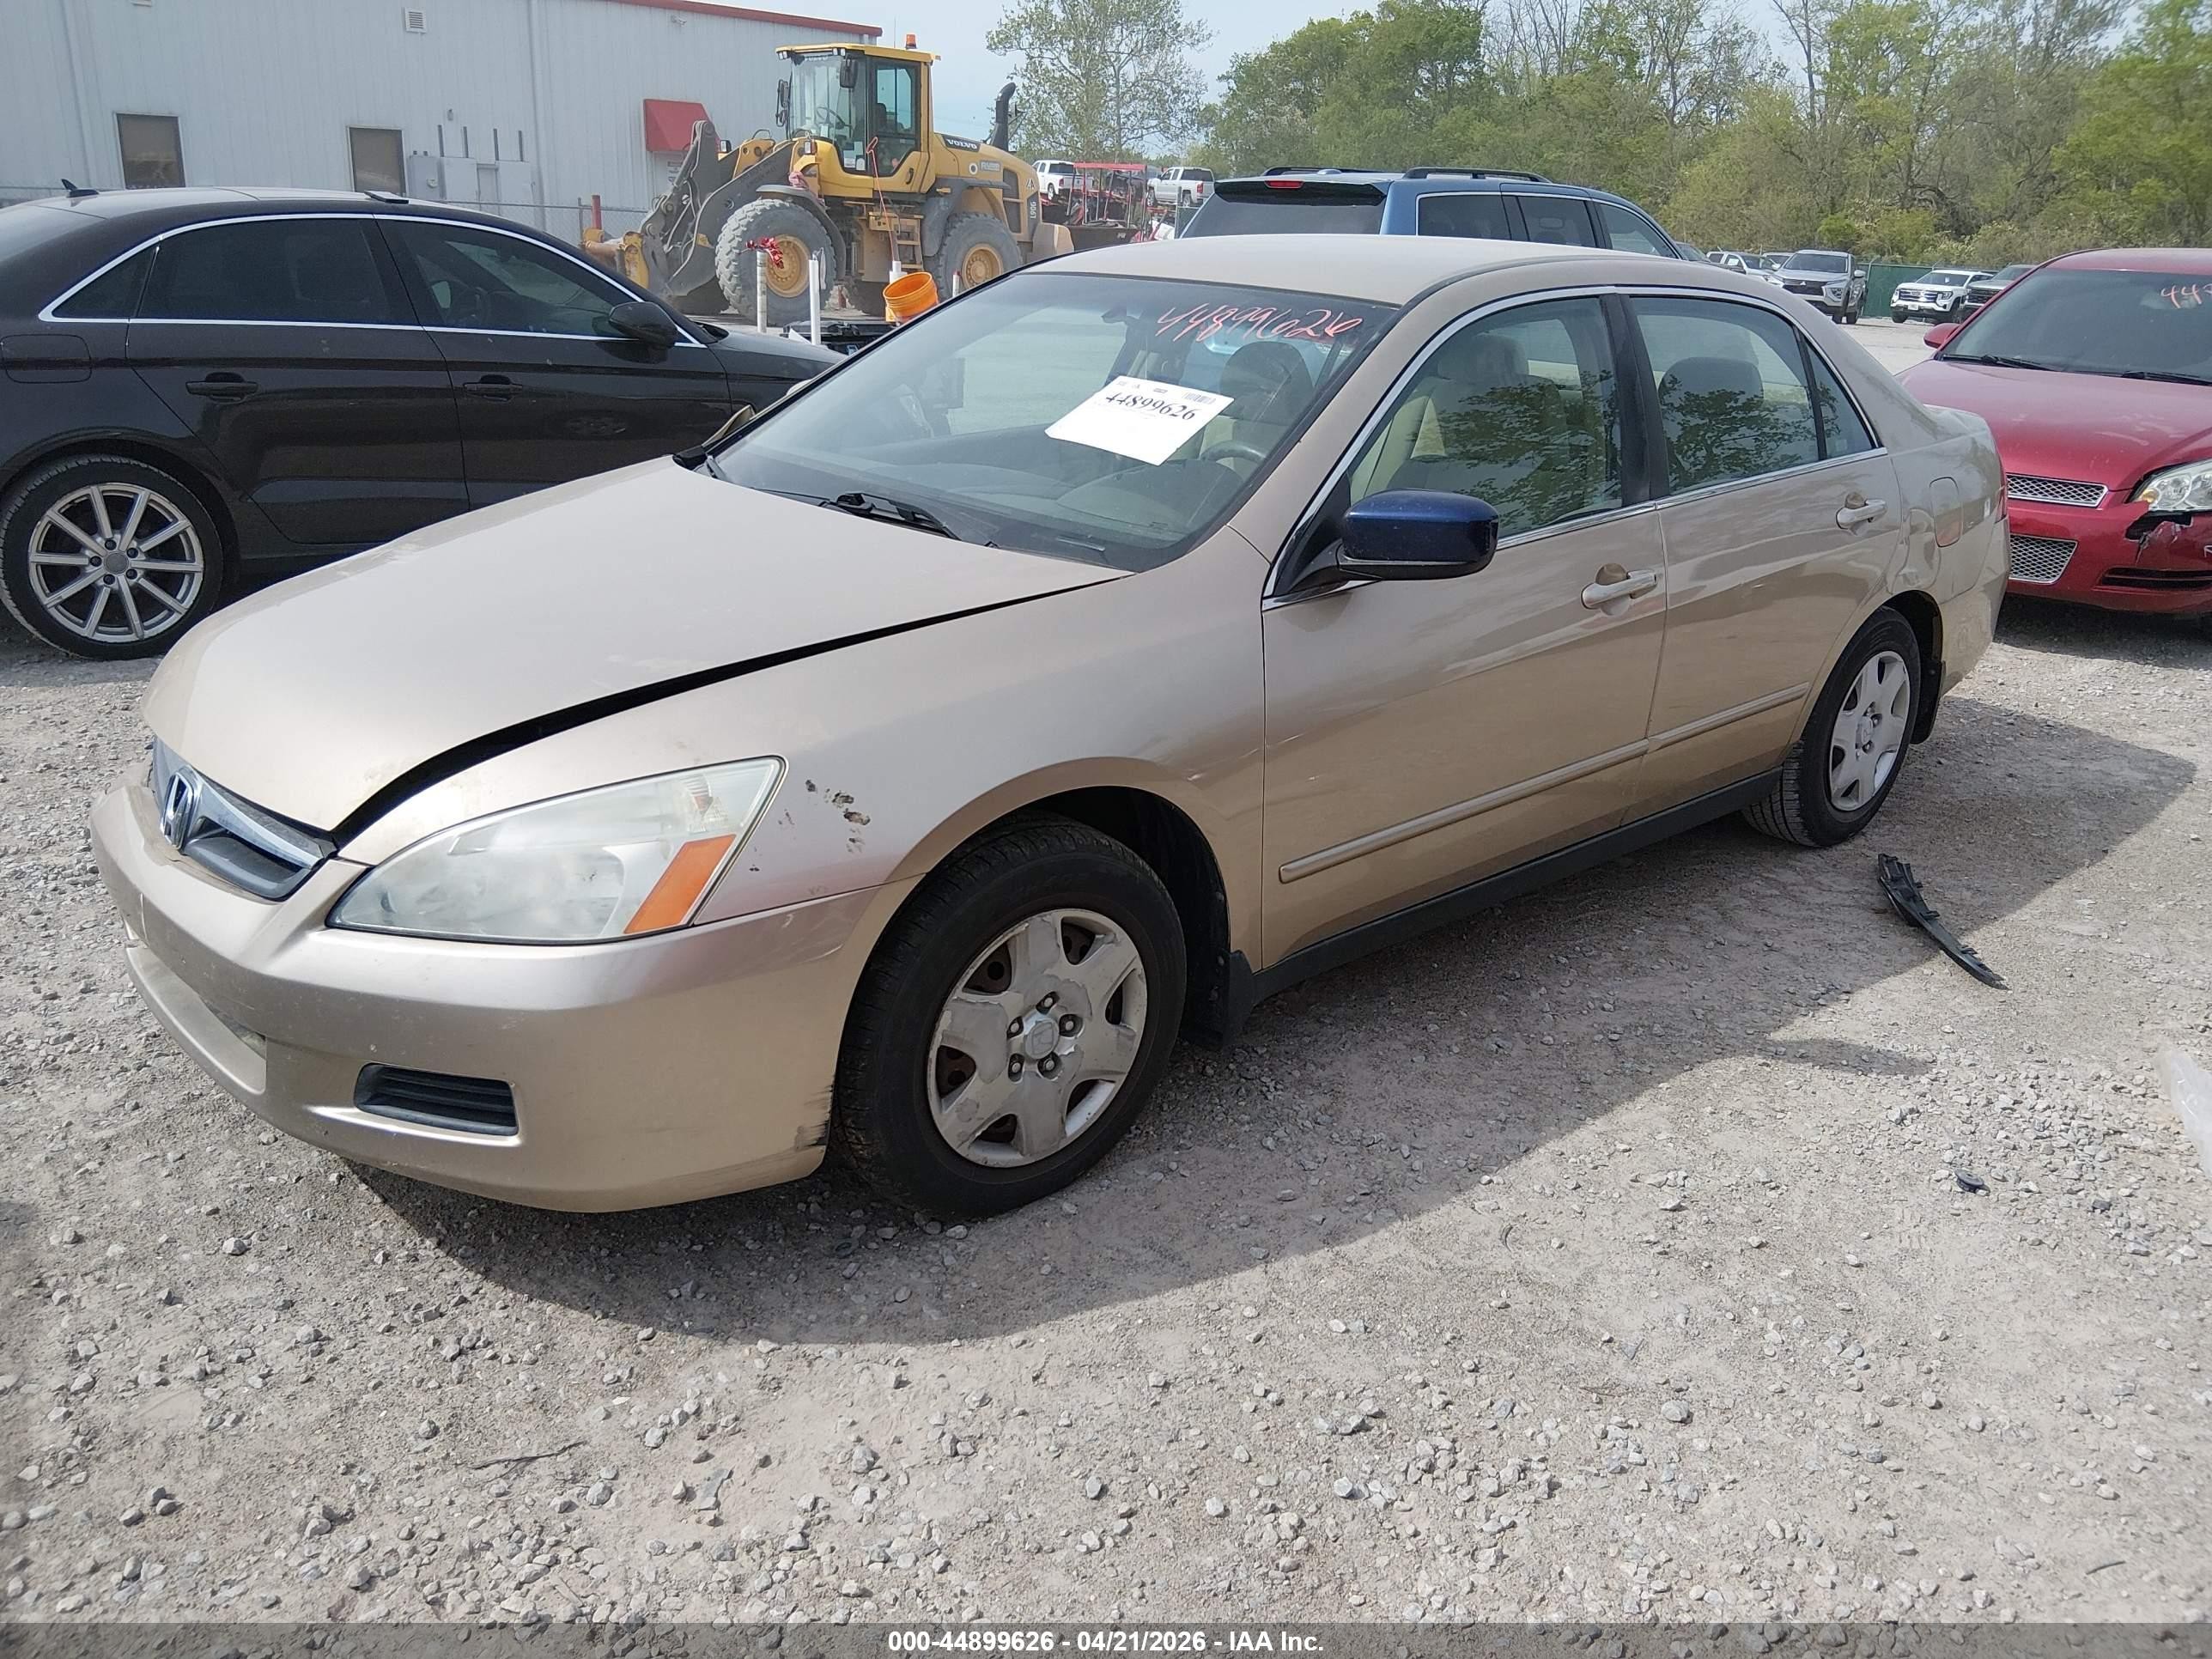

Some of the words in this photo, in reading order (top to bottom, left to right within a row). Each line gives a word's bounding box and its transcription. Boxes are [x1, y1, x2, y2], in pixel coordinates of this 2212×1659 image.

[946, 139, 978, 150] VOLVO
[1156, 302, 1364, 343] 44899626
[1105, 392, 1197, 421] 44899626
